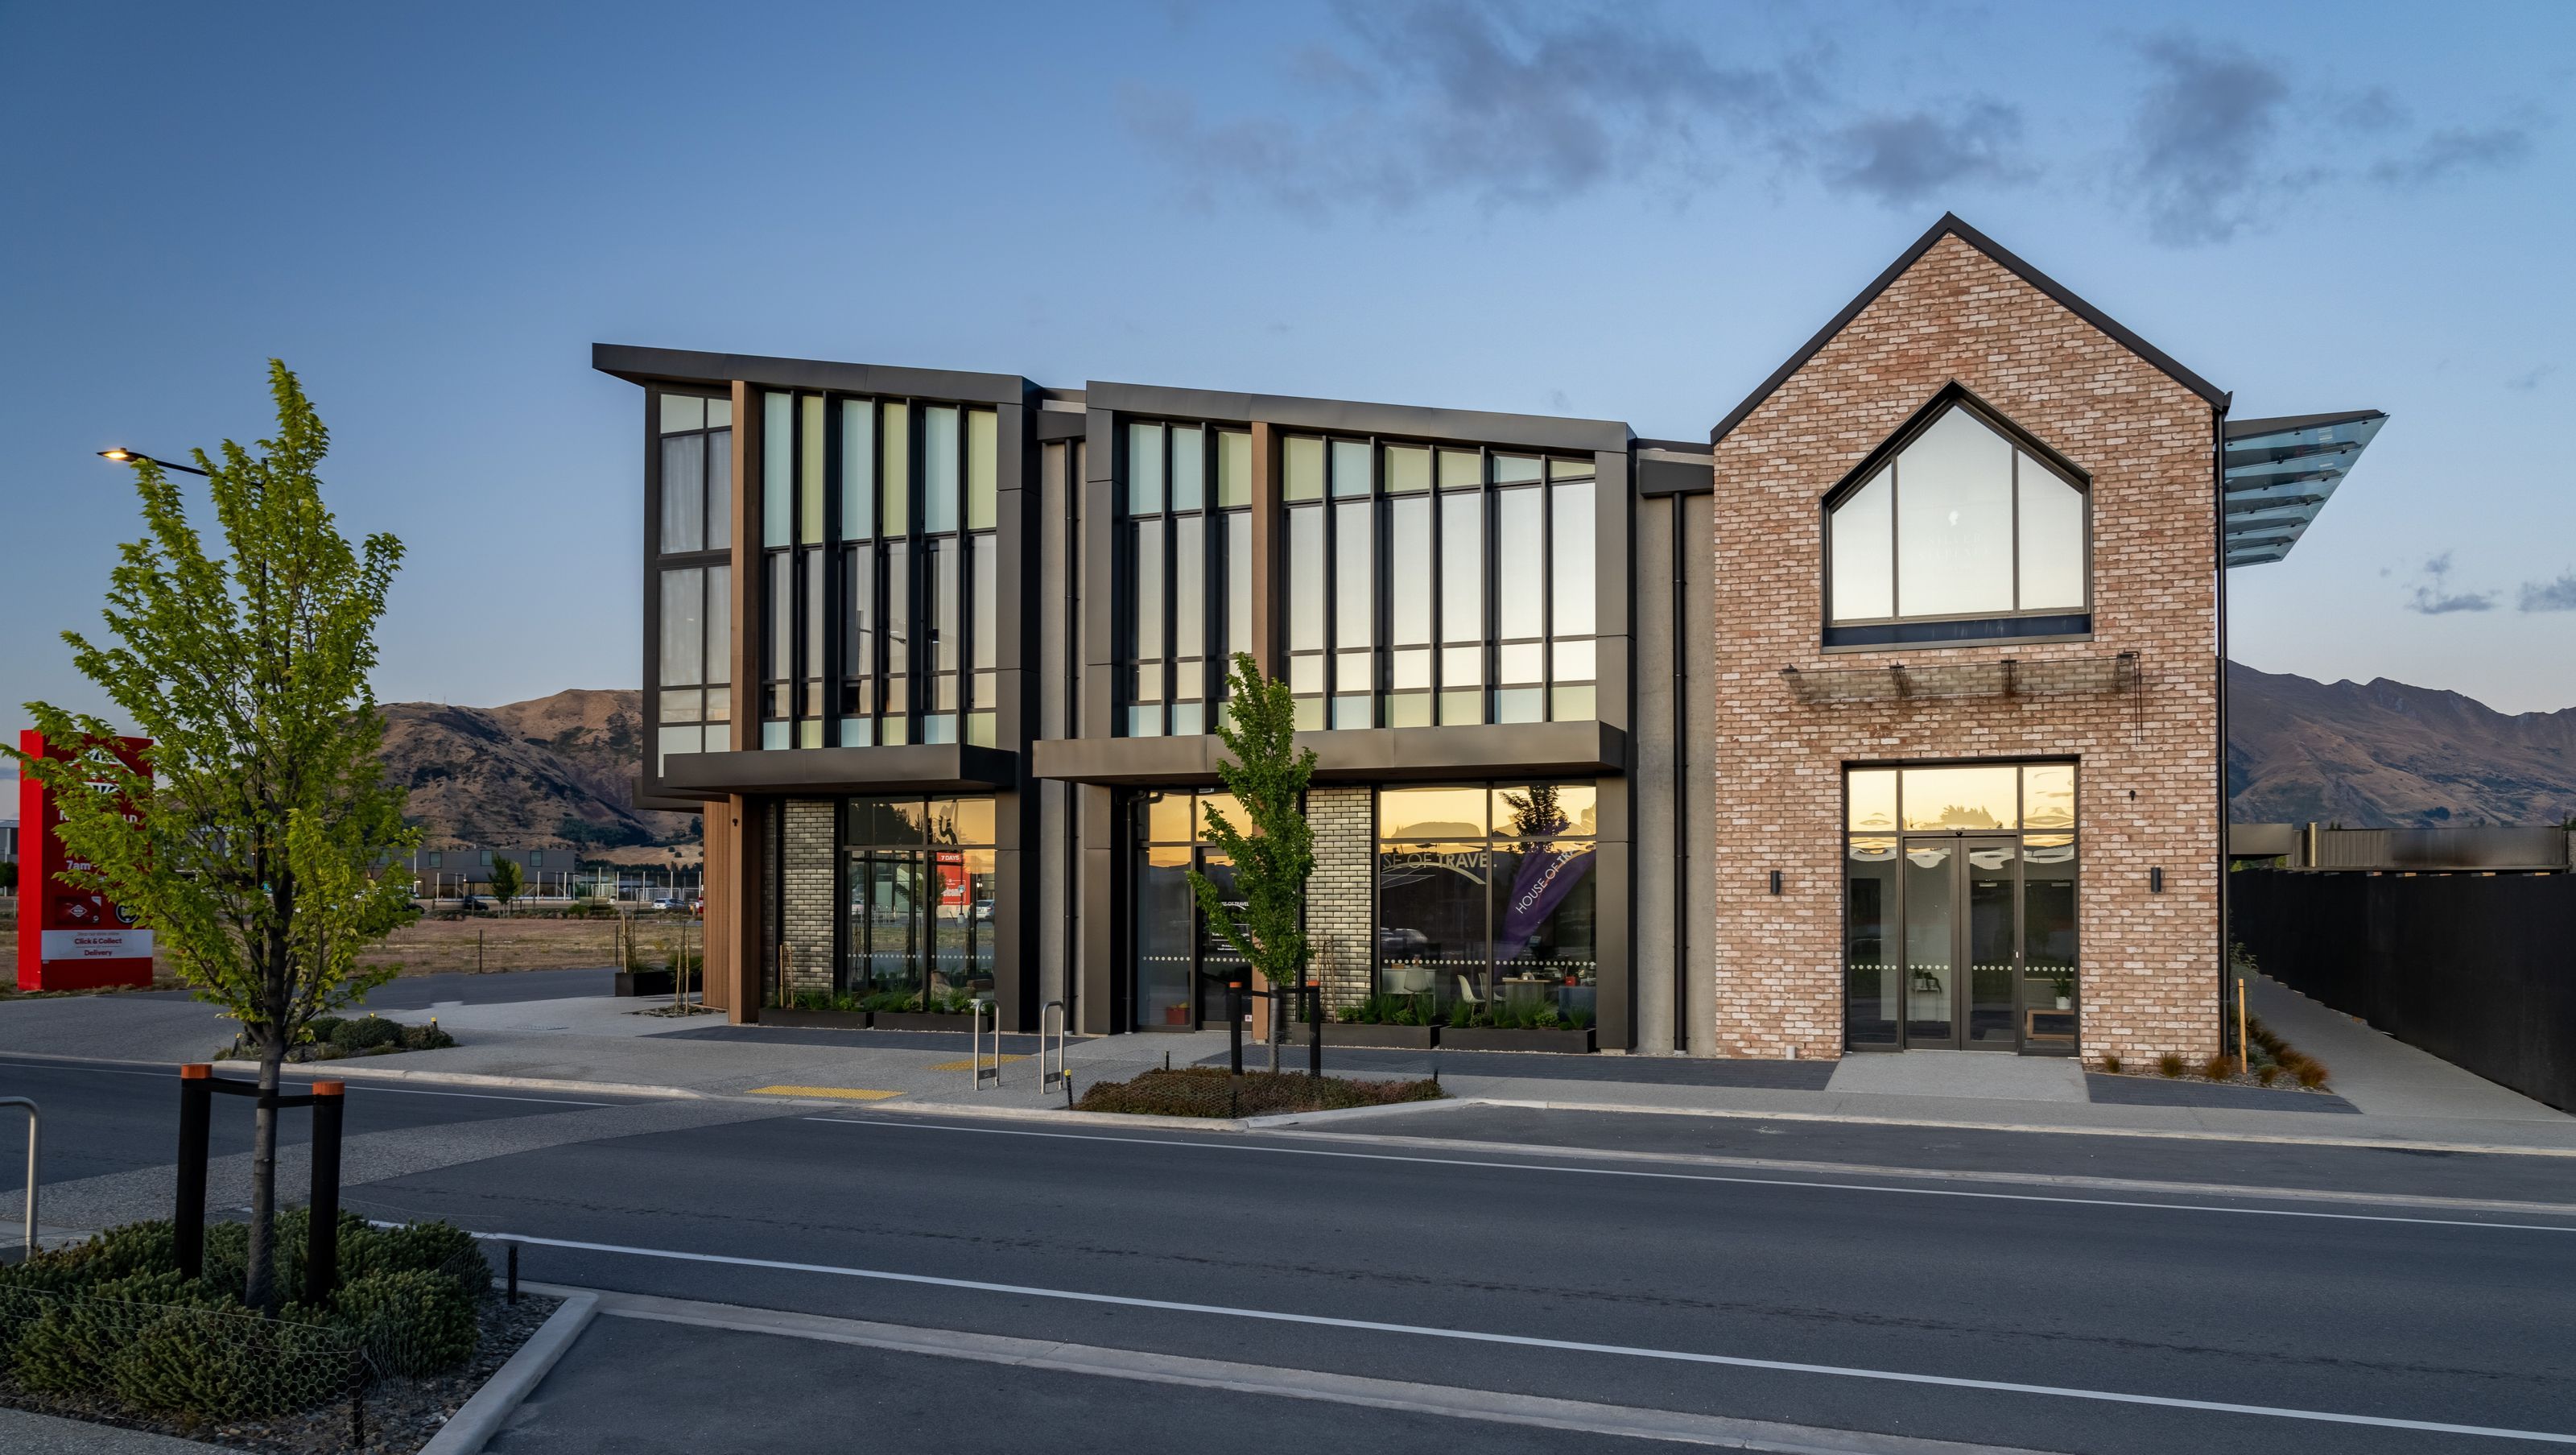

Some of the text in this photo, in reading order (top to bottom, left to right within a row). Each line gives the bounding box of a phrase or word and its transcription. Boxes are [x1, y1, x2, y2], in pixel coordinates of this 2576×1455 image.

[66, 860, 91, 870] 7am
[1407, 854, 1432, 869] OF
[1436, 852, 1497, 868] TRAVE
[1515, 878, 1548, 914] HOUSE
[1545, 862, 1559, 879] OF
